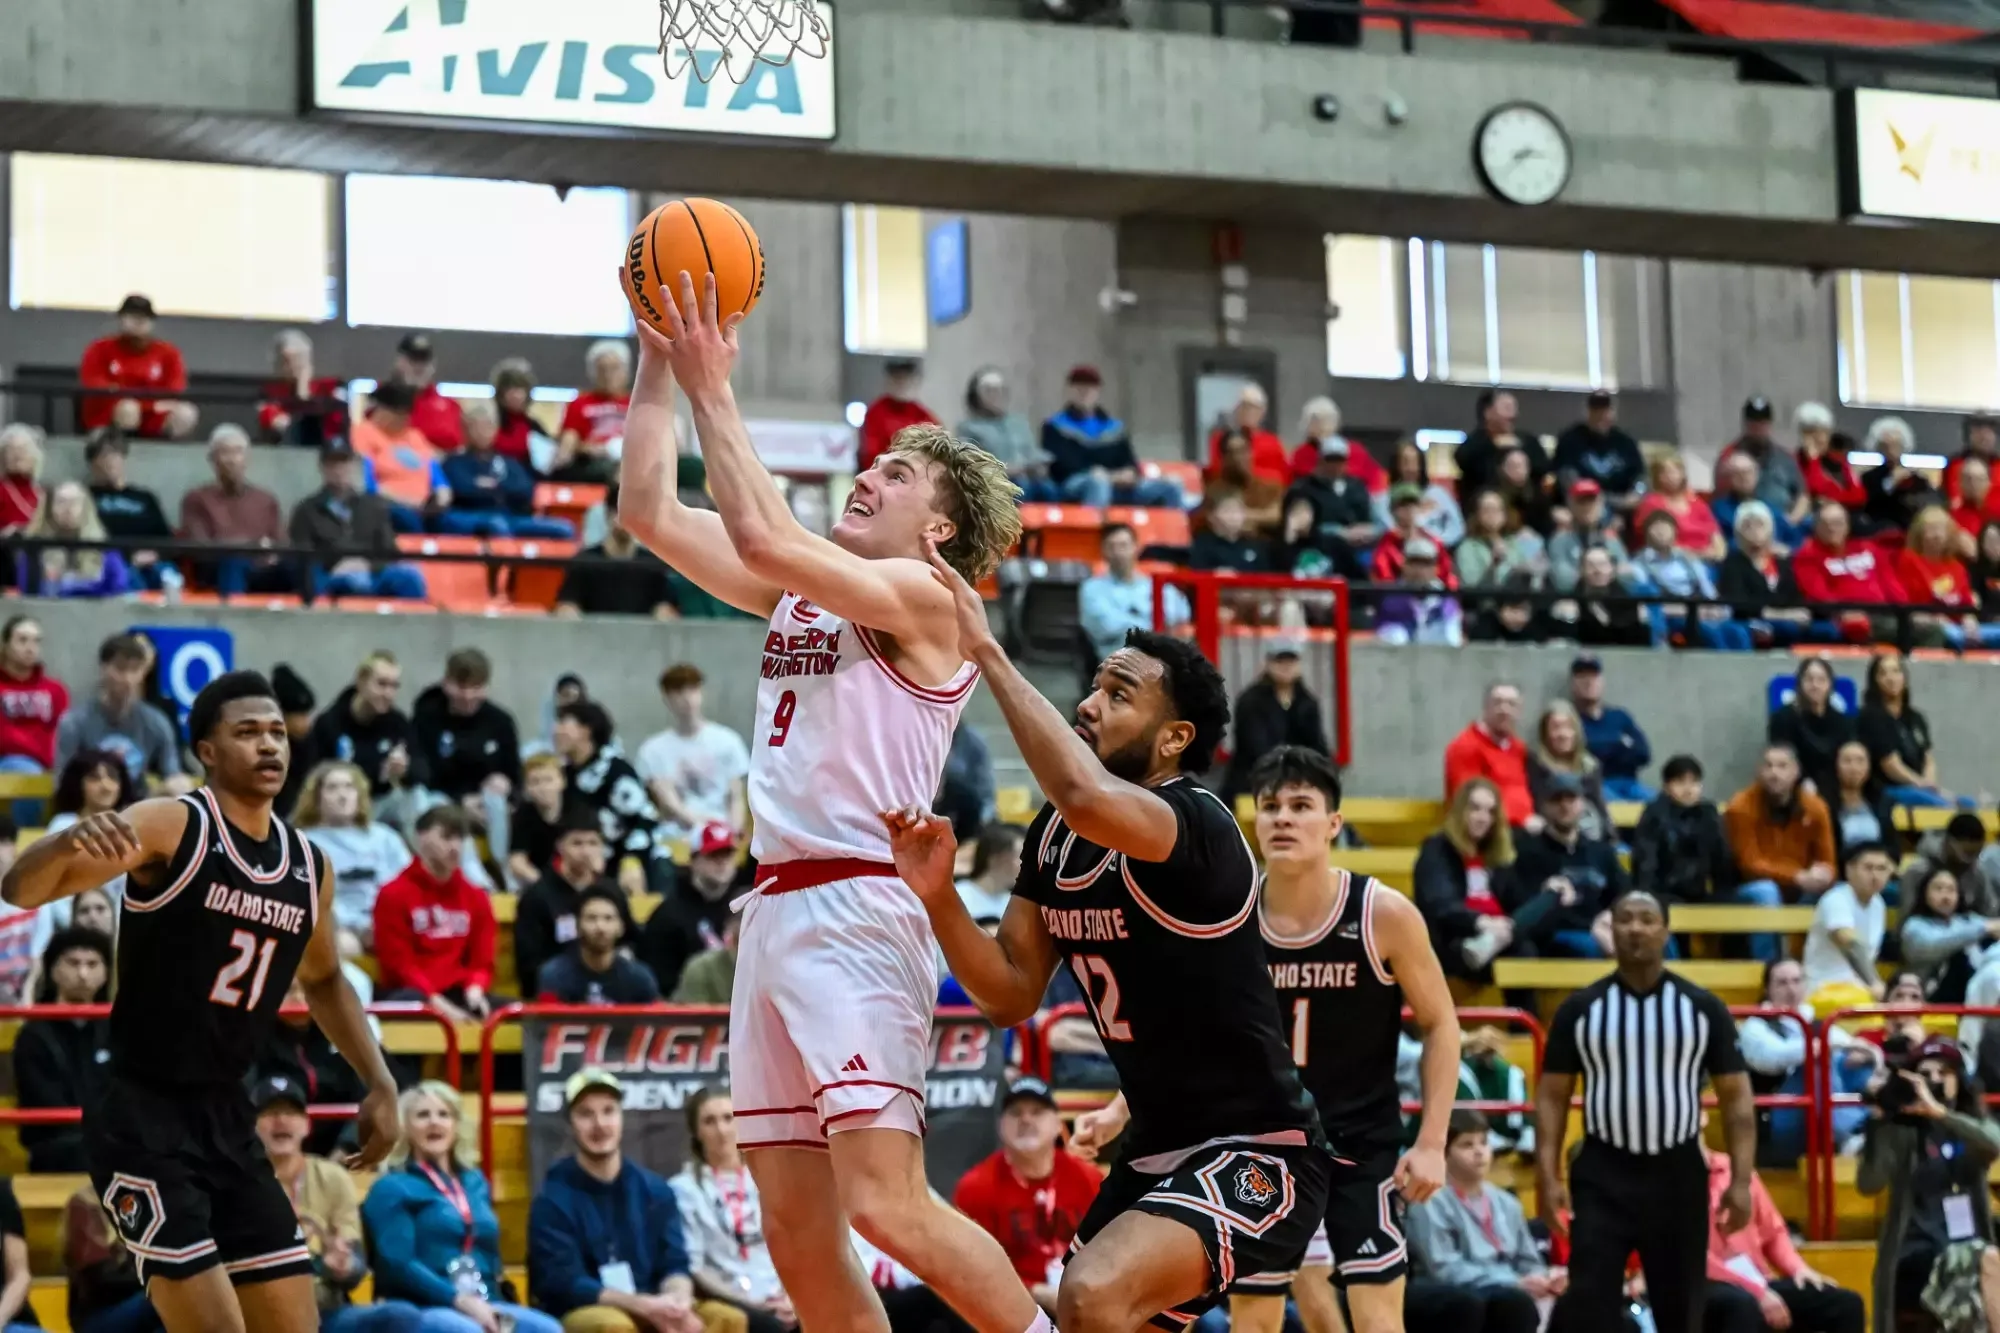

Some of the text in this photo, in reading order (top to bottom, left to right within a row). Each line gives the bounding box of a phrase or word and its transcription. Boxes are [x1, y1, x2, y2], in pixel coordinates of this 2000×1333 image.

[337, 0, 804, 115] AVISTA
[629, 230, 663, 322] Wilson
[768, 690, 797, 748] 9
[204, 881, 306, 935] IDAHO STATE
[1084, 906, 1129, 941] STATE
[208, 928, 278, 1012] 21
[1071, 953, 1134, 1041] 12
[1300, 963, 1357, 988] STATE
[1292, 997, 1310, 1068] 1
[536, 1079, 704, 1112] SDENT
[925, 1077, 998, 1109] ION
